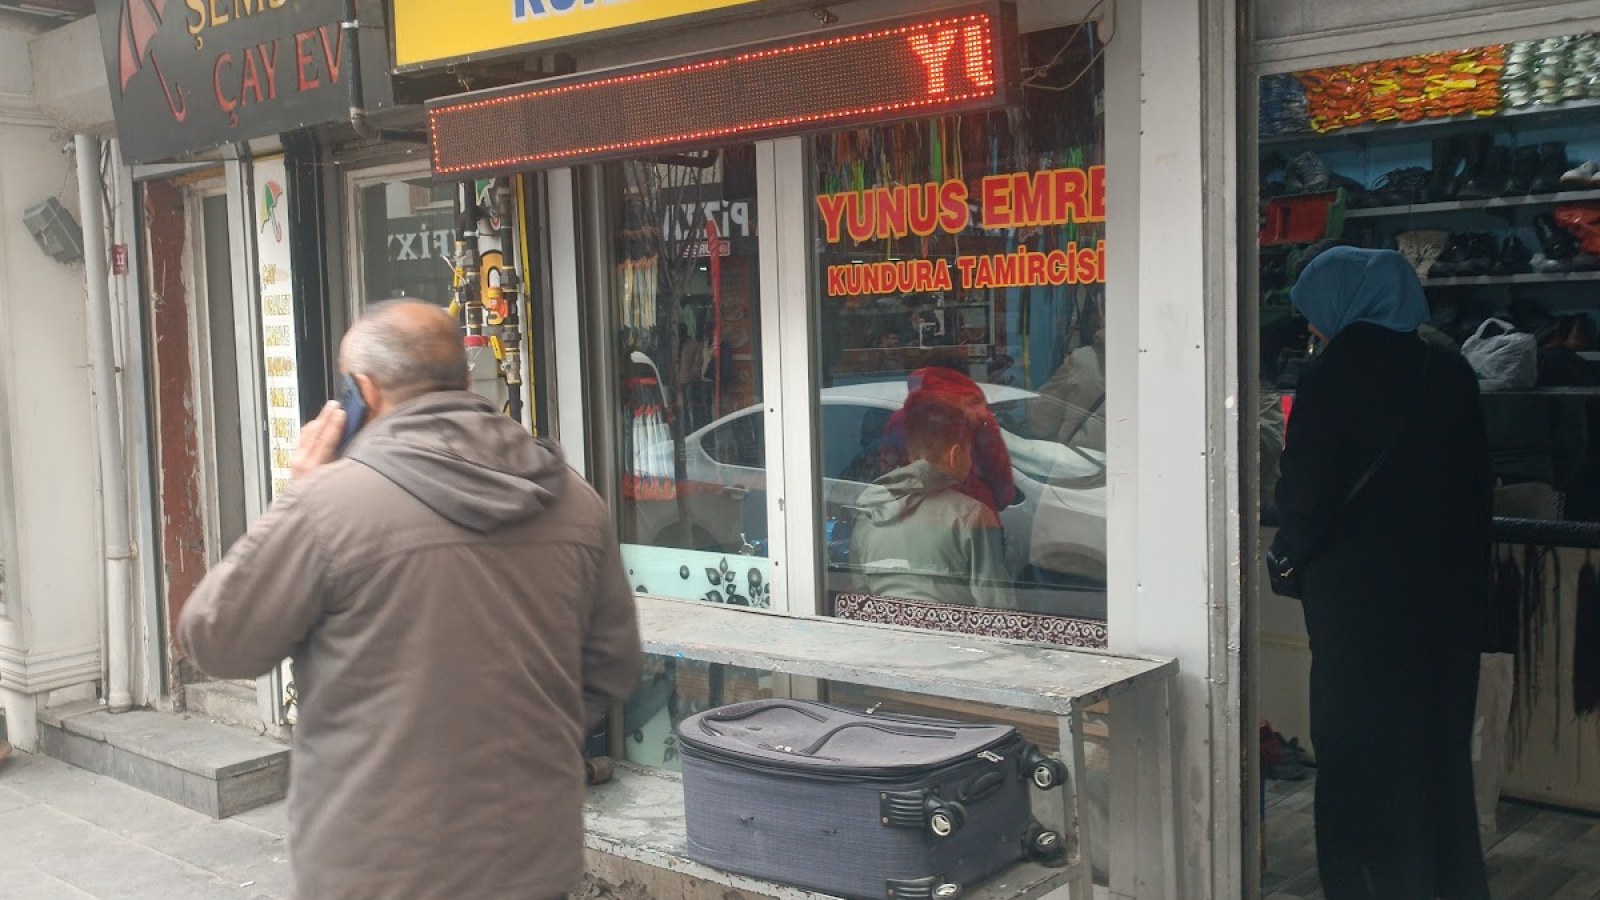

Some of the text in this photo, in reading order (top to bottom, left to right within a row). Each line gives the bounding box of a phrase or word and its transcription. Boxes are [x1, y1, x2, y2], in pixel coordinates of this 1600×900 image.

[213, 38, 280, 128] ÇAY
[817, 165, 1106, 243] YUNUS EMRE
[828, 240, 1106, 296] KUNDURA TAMİRCİSİ
